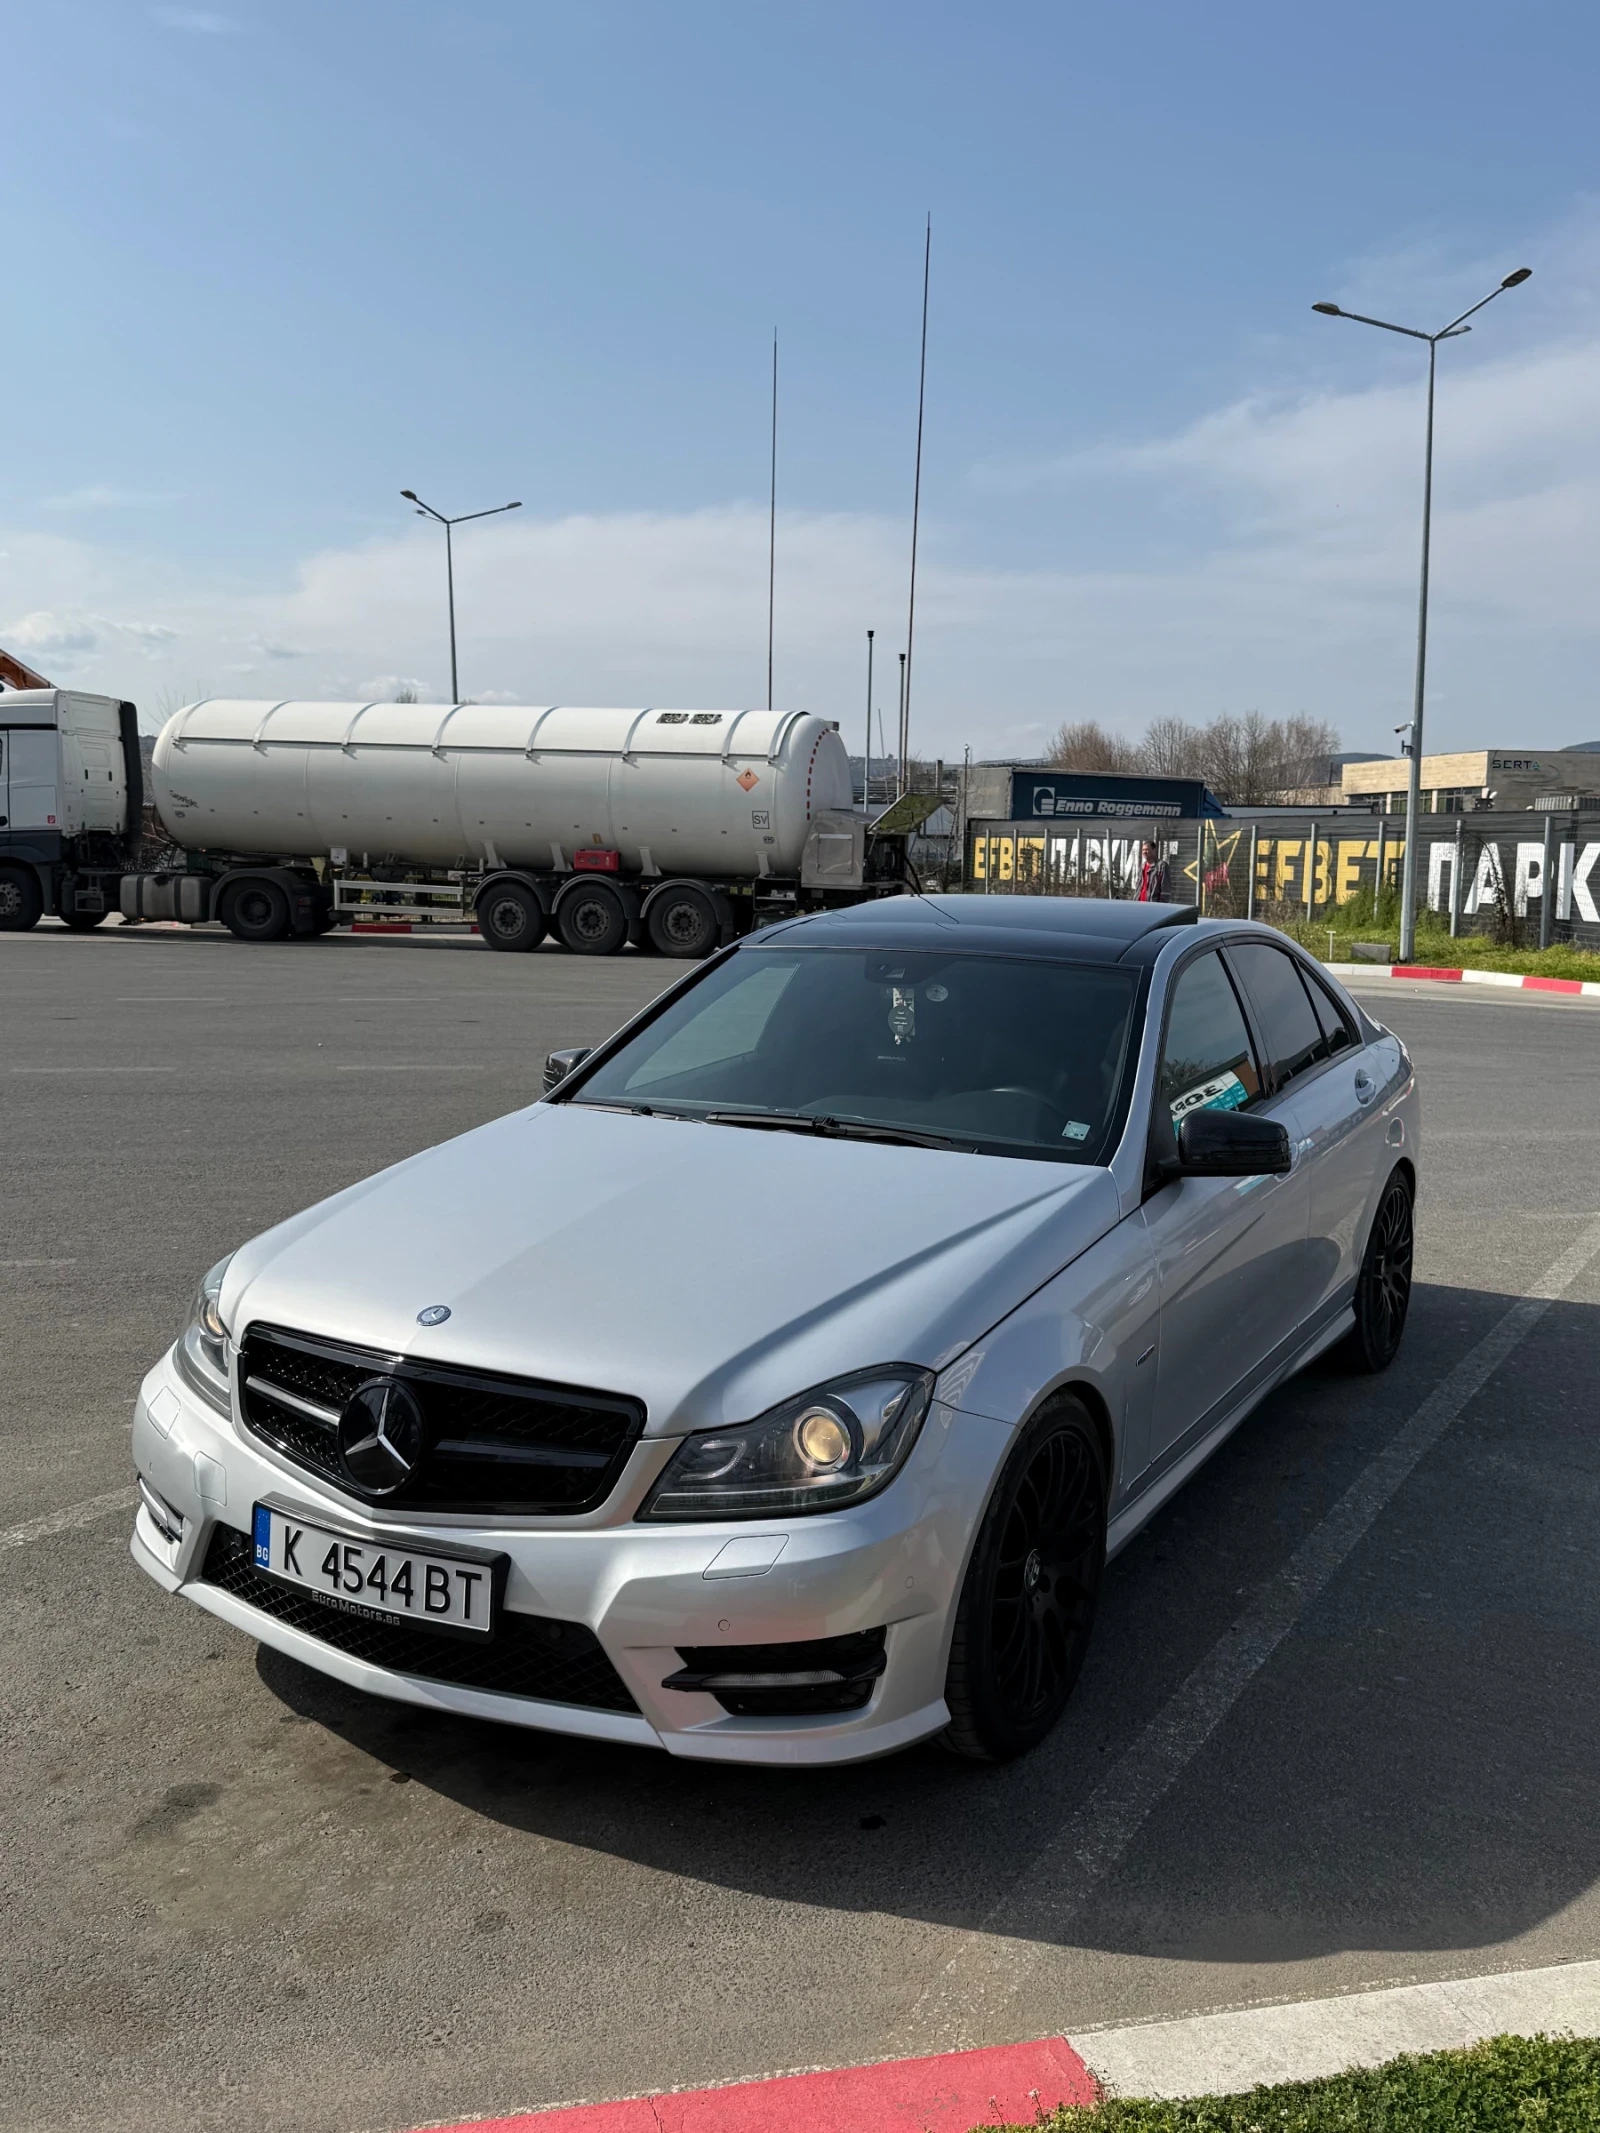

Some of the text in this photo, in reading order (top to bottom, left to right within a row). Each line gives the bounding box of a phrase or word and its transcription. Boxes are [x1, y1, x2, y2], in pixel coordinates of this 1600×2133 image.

[1492, 759, 1541, 770] SERTA
[1055, 799, 1182, 816] Enno Roggemann
[753, 815, 767, 824] SV
[1250, 840, 1406, 905] EFBET
[256, 1544, 269, 1561] BG
[283, 1525, 304, 1577] K
